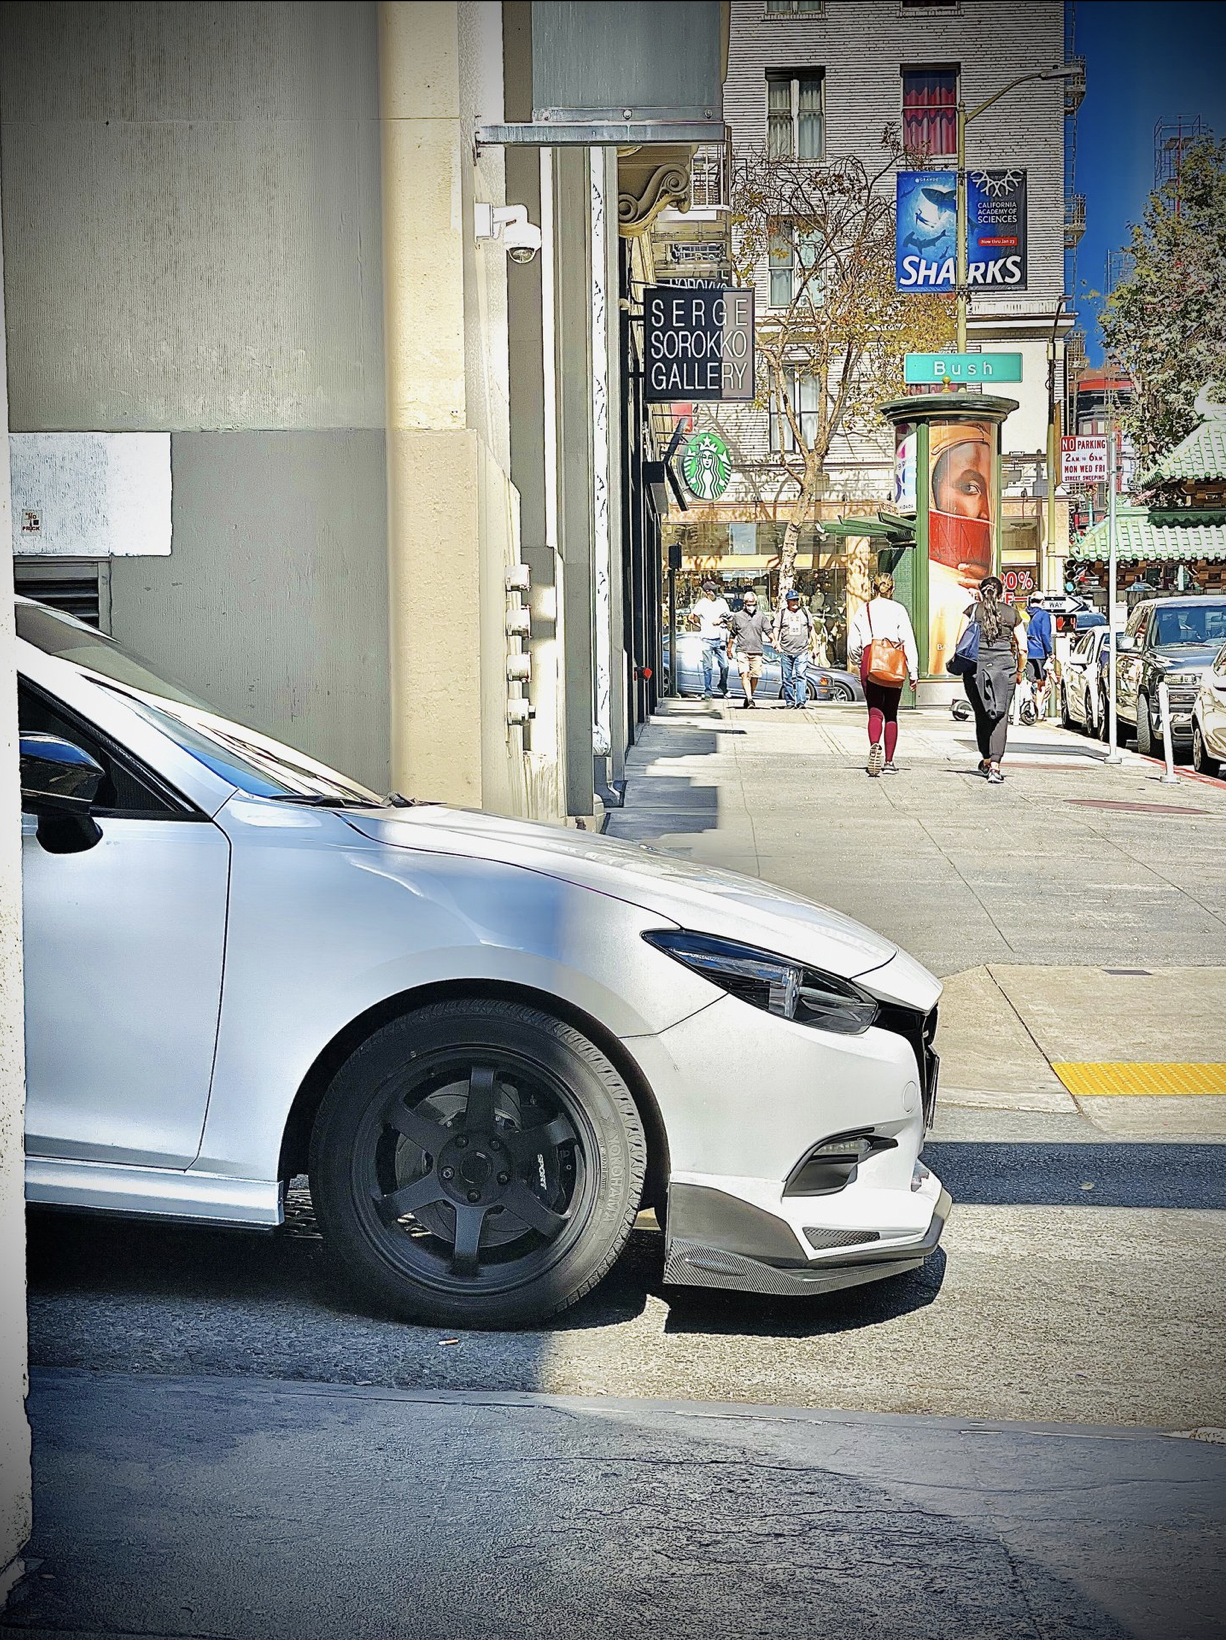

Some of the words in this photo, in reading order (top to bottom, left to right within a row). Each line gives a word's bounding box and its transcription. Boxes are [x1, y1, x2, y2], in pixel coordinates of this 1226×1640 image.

[978, 215, 1017, 223] SCIENCES
[900, 255, 1021, 285] SHARKS
[651, 299, 748, 327] SERGE
[651, 330, 747, 359] SOROKKO
[651, 362, 747, 390] GALLERY
[934, 360, 993, 376] Bush
[1062, 439, 1075, 450] NO
[1077, 440, 1106, 449] PARKING
[1064, 465, 1078, 473] MON
[537, 1153, 547, 1190] SPORT
[603, 1133, 623, 1222] YOKOHAMA
